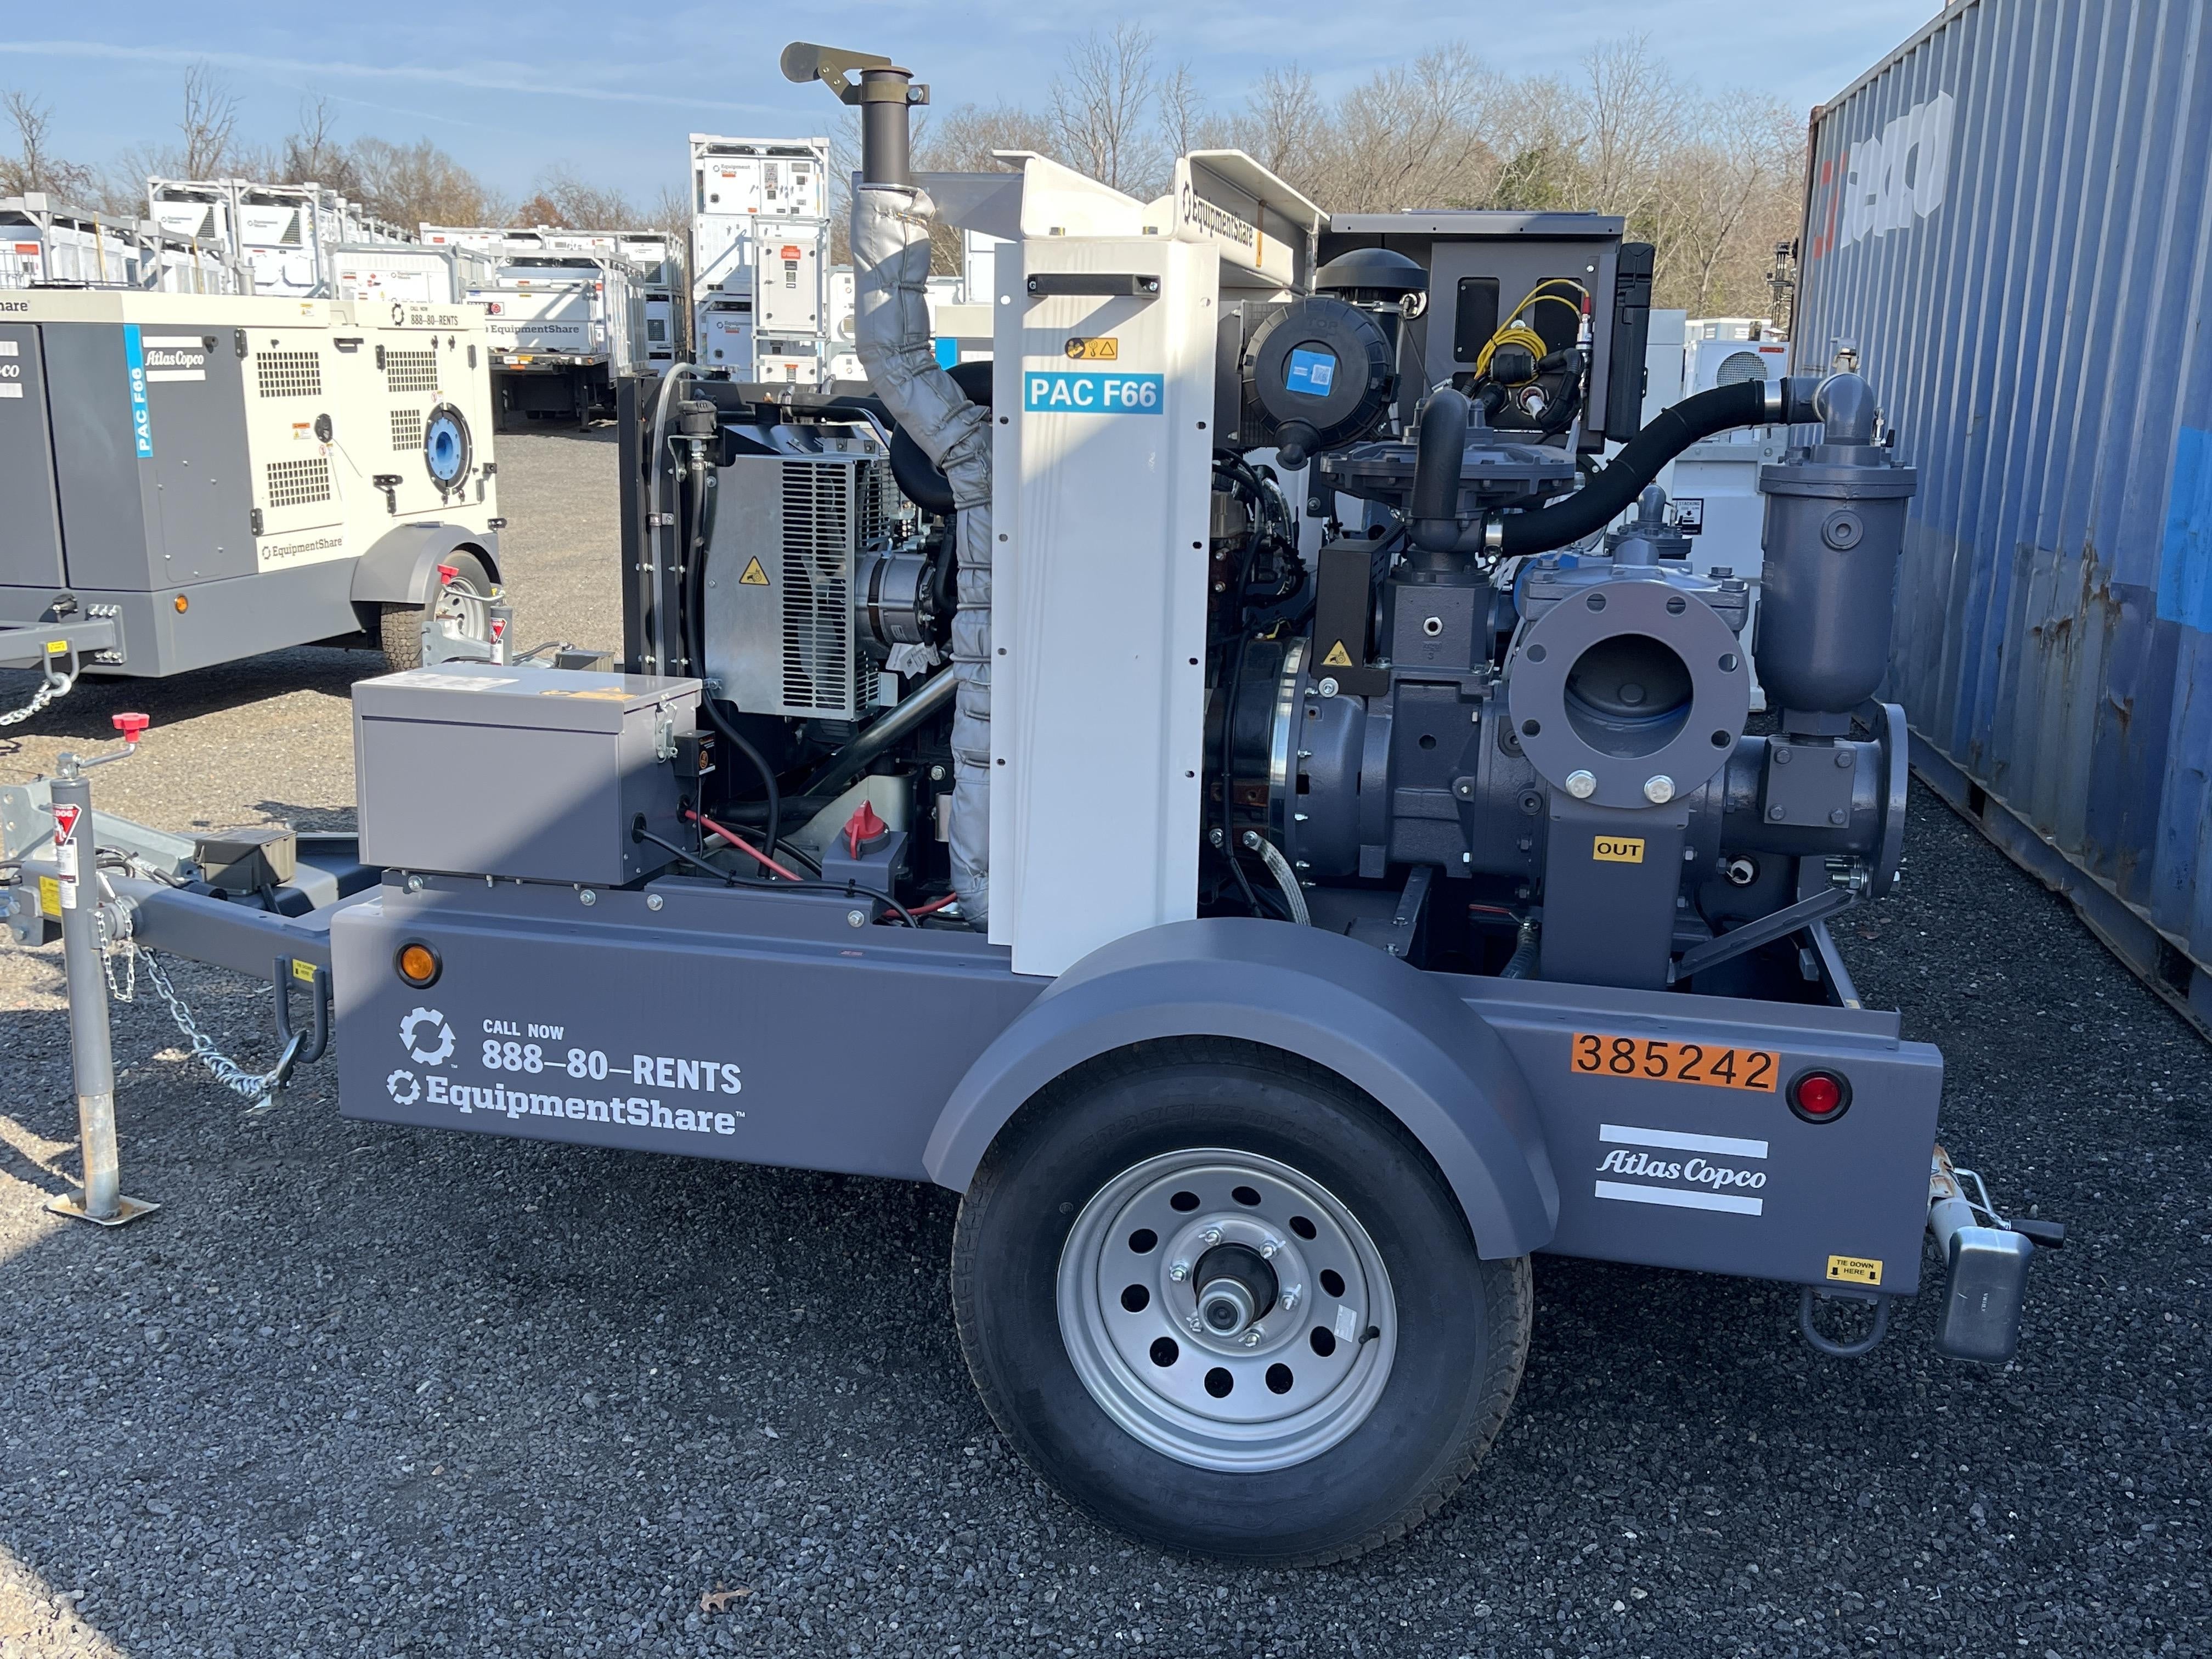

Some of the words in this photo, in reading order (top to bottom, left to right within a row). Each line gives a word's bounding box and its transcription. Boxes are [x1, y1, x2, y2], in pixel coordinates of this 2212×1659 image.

[1193, 189, 1253, 248] EquipmentShare
[490, 325, 579, 334] EquipmentShare
[144, 350, 176, 366] Atlas
[175, 350, 205, 368] Copco
[131, 368, 145, 403] F66
[1031, 378, 1094, 406] PAC
[1103, 380, 1156, 408] F66
[136, 409, 150, 451] PAC
[272, 538, 342, 557] EquipmentShare
[1597, 842, 1641, 856] OUT
[482, 1018, 521, 1036] CALL
[528, 1023, 564, 1040] NOW
[1577, 1034, 1771, 1089] 385242
[425, 1075, 736, 1135] EquipmentShare
[1595, 1149, 1681, 1180] Atlas
[1683, 1158, 1767, 1189] Copco
